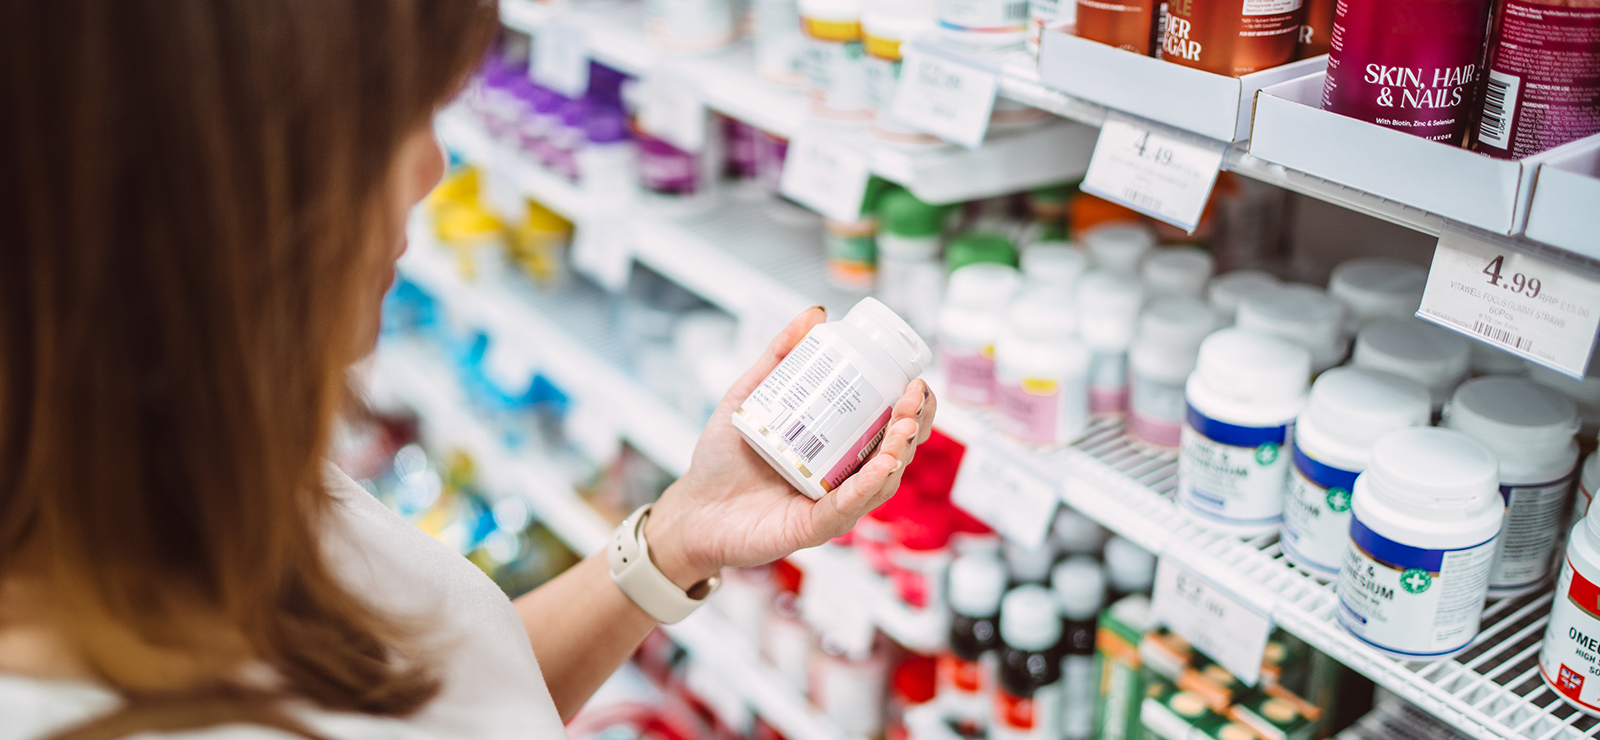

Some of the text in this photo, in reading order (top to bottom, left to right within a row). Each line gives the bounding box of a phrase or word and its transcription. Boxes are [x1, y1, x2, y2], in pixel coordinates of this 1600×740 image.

[1364, 63, 1475, 90] SKIN, HAIR
[1376, 87, 1463, 109] & NAILS
[1376, 117, 1391, 125] With
[1392, 119, 1412, 127] Biotin,
[1432, 118, 1455, 126] Selenium
[1482, 254, 1542, 299] 4.99
[1538, 292, 1559, 306] RRP
[1450, 280, 1482, 299] VITAWELL
[1482, 292, 1507, 308] FOCUS
[1507, 300, 1535, 317] GUMMY
[1368, 565, 1375, 578] &
[1569, 626, 1600, 655] OME
[1575, 647, 1596, 665] HIGH
